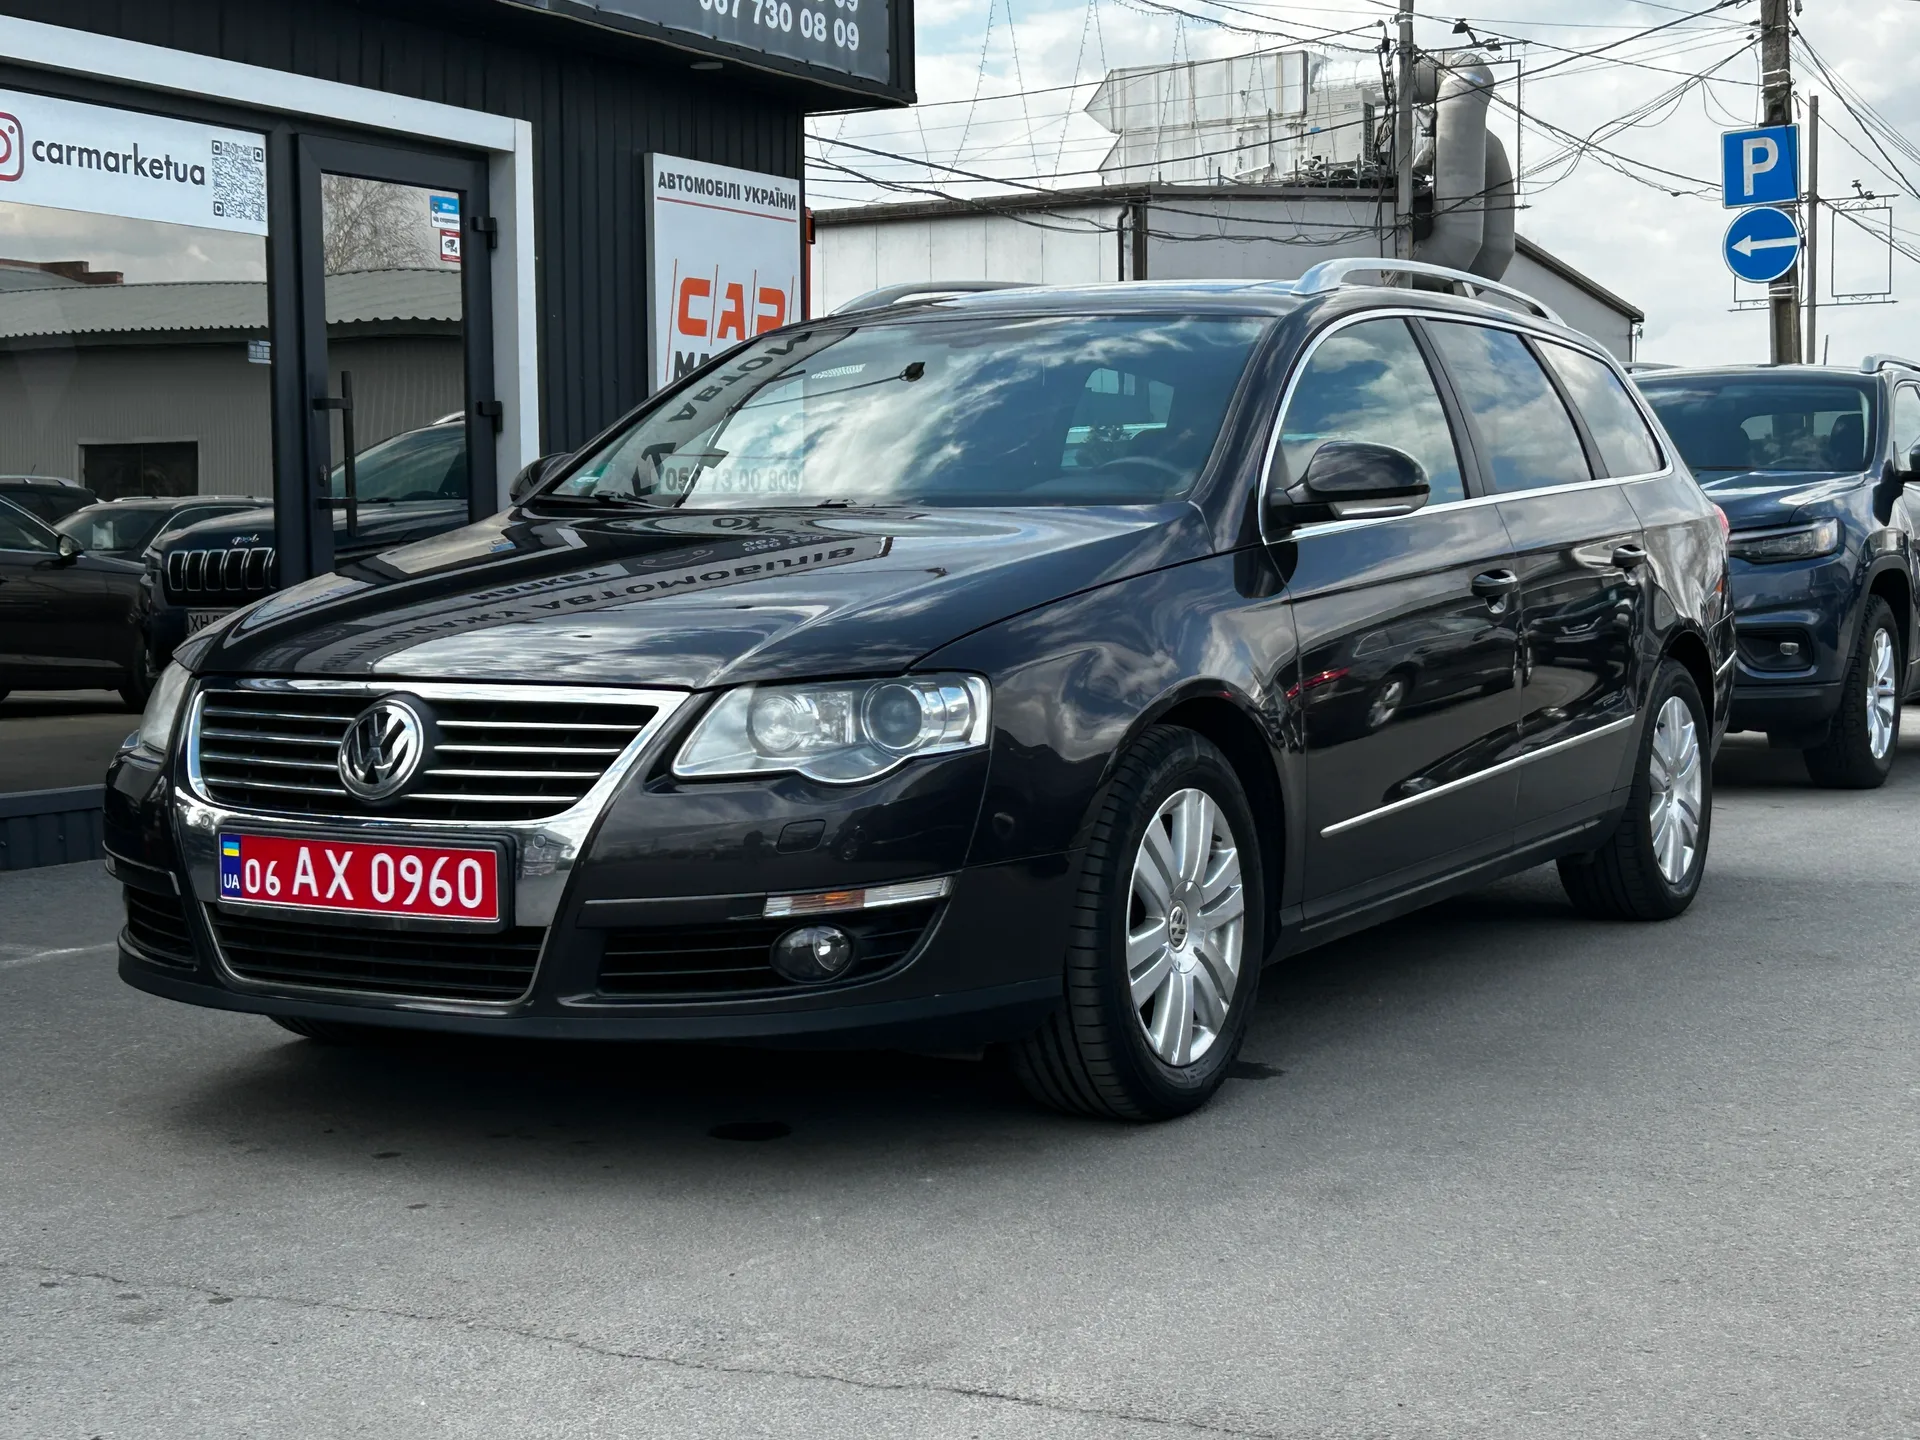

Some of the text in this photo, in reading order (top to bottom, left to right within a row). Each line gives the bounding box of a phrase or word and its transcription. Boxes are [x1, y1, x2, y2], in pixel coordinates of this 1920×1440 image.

[753, 0, 792, 32] 730
[800, 8, 826, 42] 08
[833, 18, 859, 51] 09
[32, 139, 206, 186] carmarketua
[1742, 136, 1779, 197] P
[658, 171, 797, 211] АВТОМОБІЛІ УКРАЇНИ
[678, 277, 786, 341] CAR
[224, 872, 240, 890] UA
[245, 846, 483, 909] 06 AX 0960
